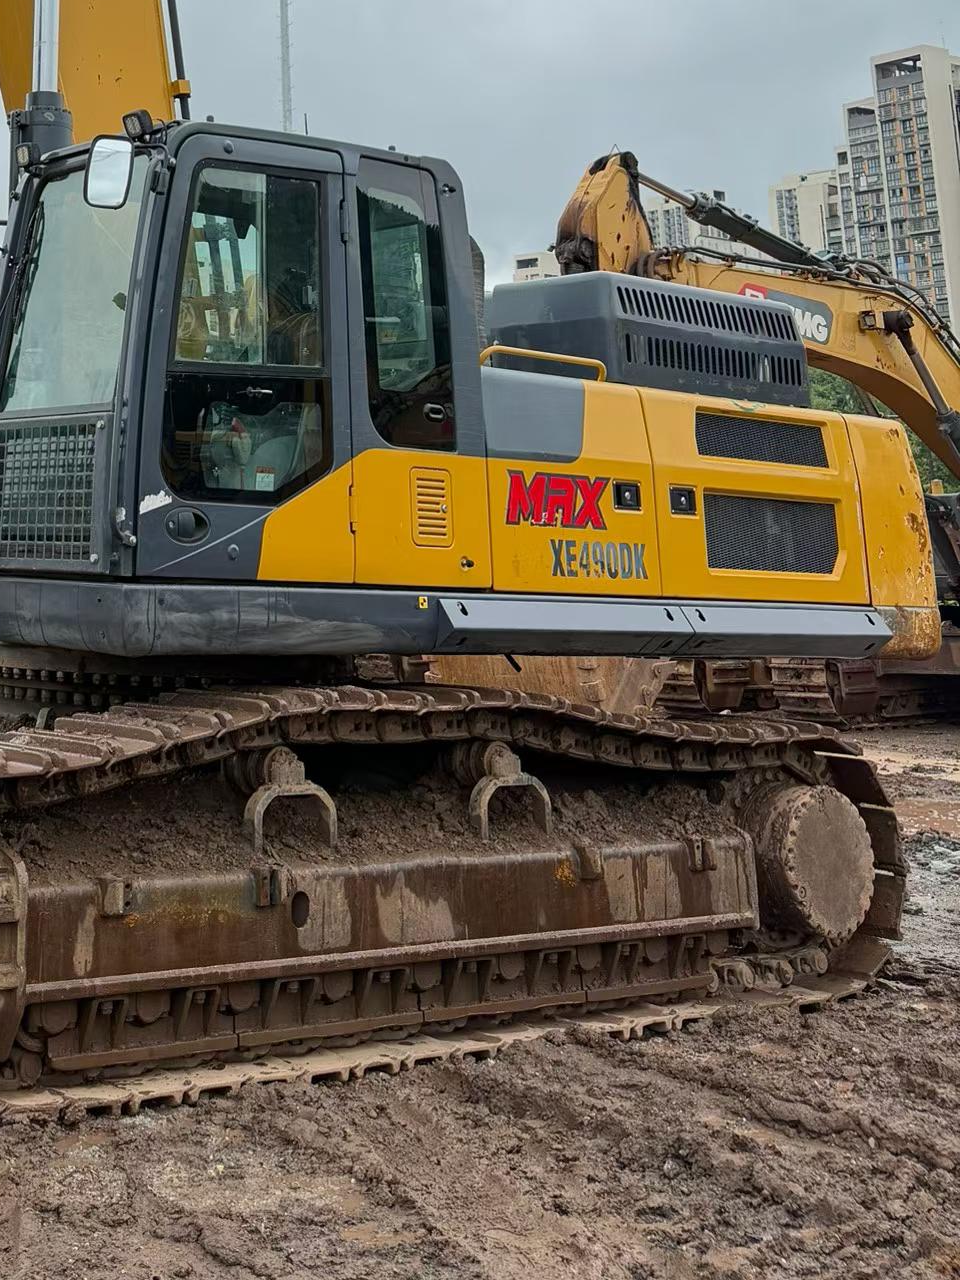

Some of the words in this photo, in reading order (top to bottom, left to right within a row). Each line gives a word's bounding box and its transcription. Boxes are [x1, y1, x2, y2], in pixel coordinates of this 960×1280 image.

[793, 307, 828, 342] MG
[506, 469, 611, 530] MAX
[550, 539, 648, 580] XE490DK
